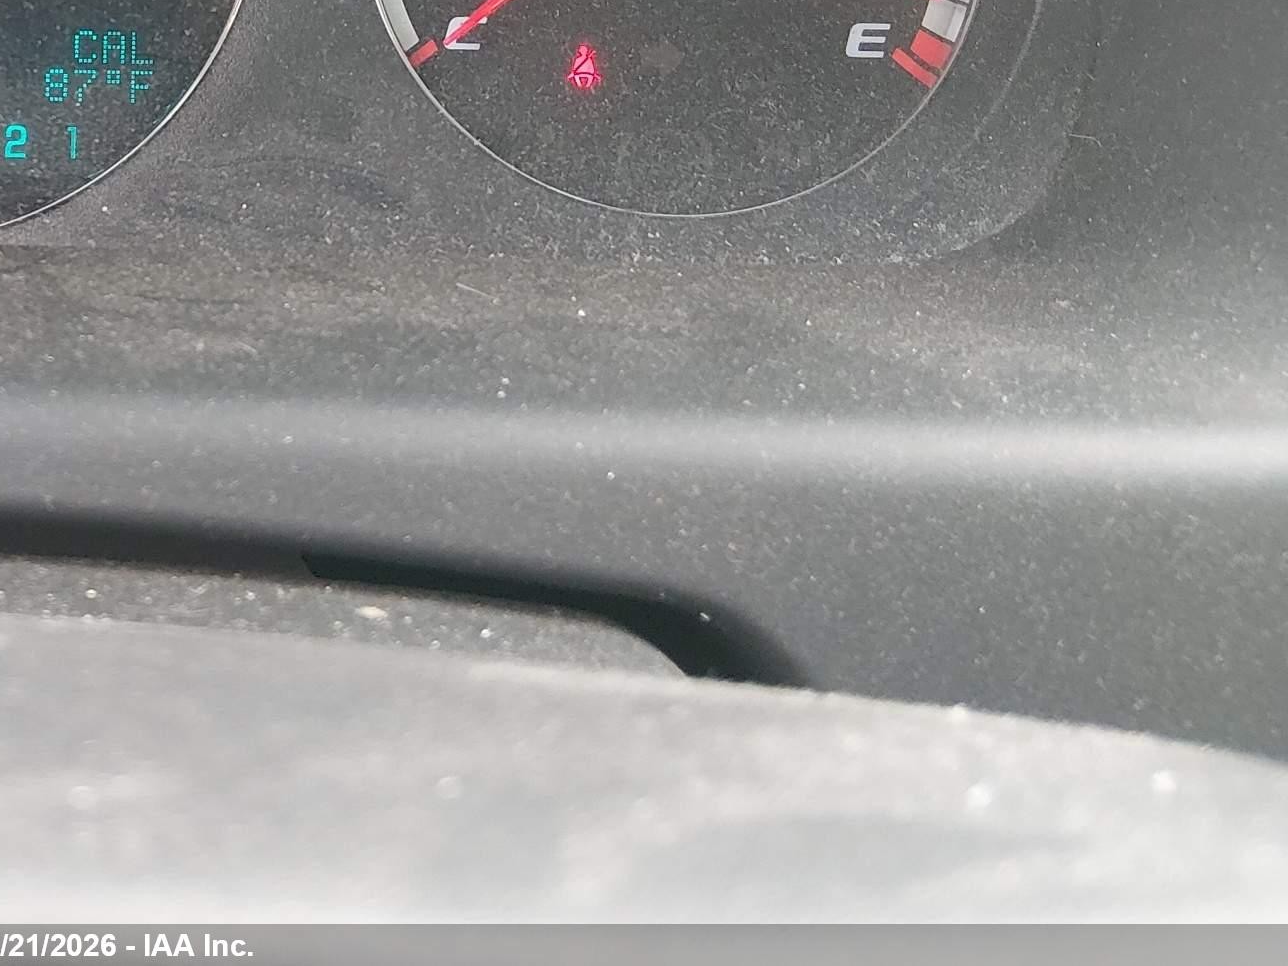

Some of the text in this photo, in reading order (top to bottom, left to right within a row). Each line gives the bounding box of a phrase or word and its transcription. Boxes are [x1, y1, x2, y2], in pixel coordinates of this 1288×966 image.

[73, 29, 154, 65] CAL
[443, 16, 488, 51] C
[845, 23, 892, 59] E
[4, 124, 28, 159] 2
[66, 126, 79, 160] 1
